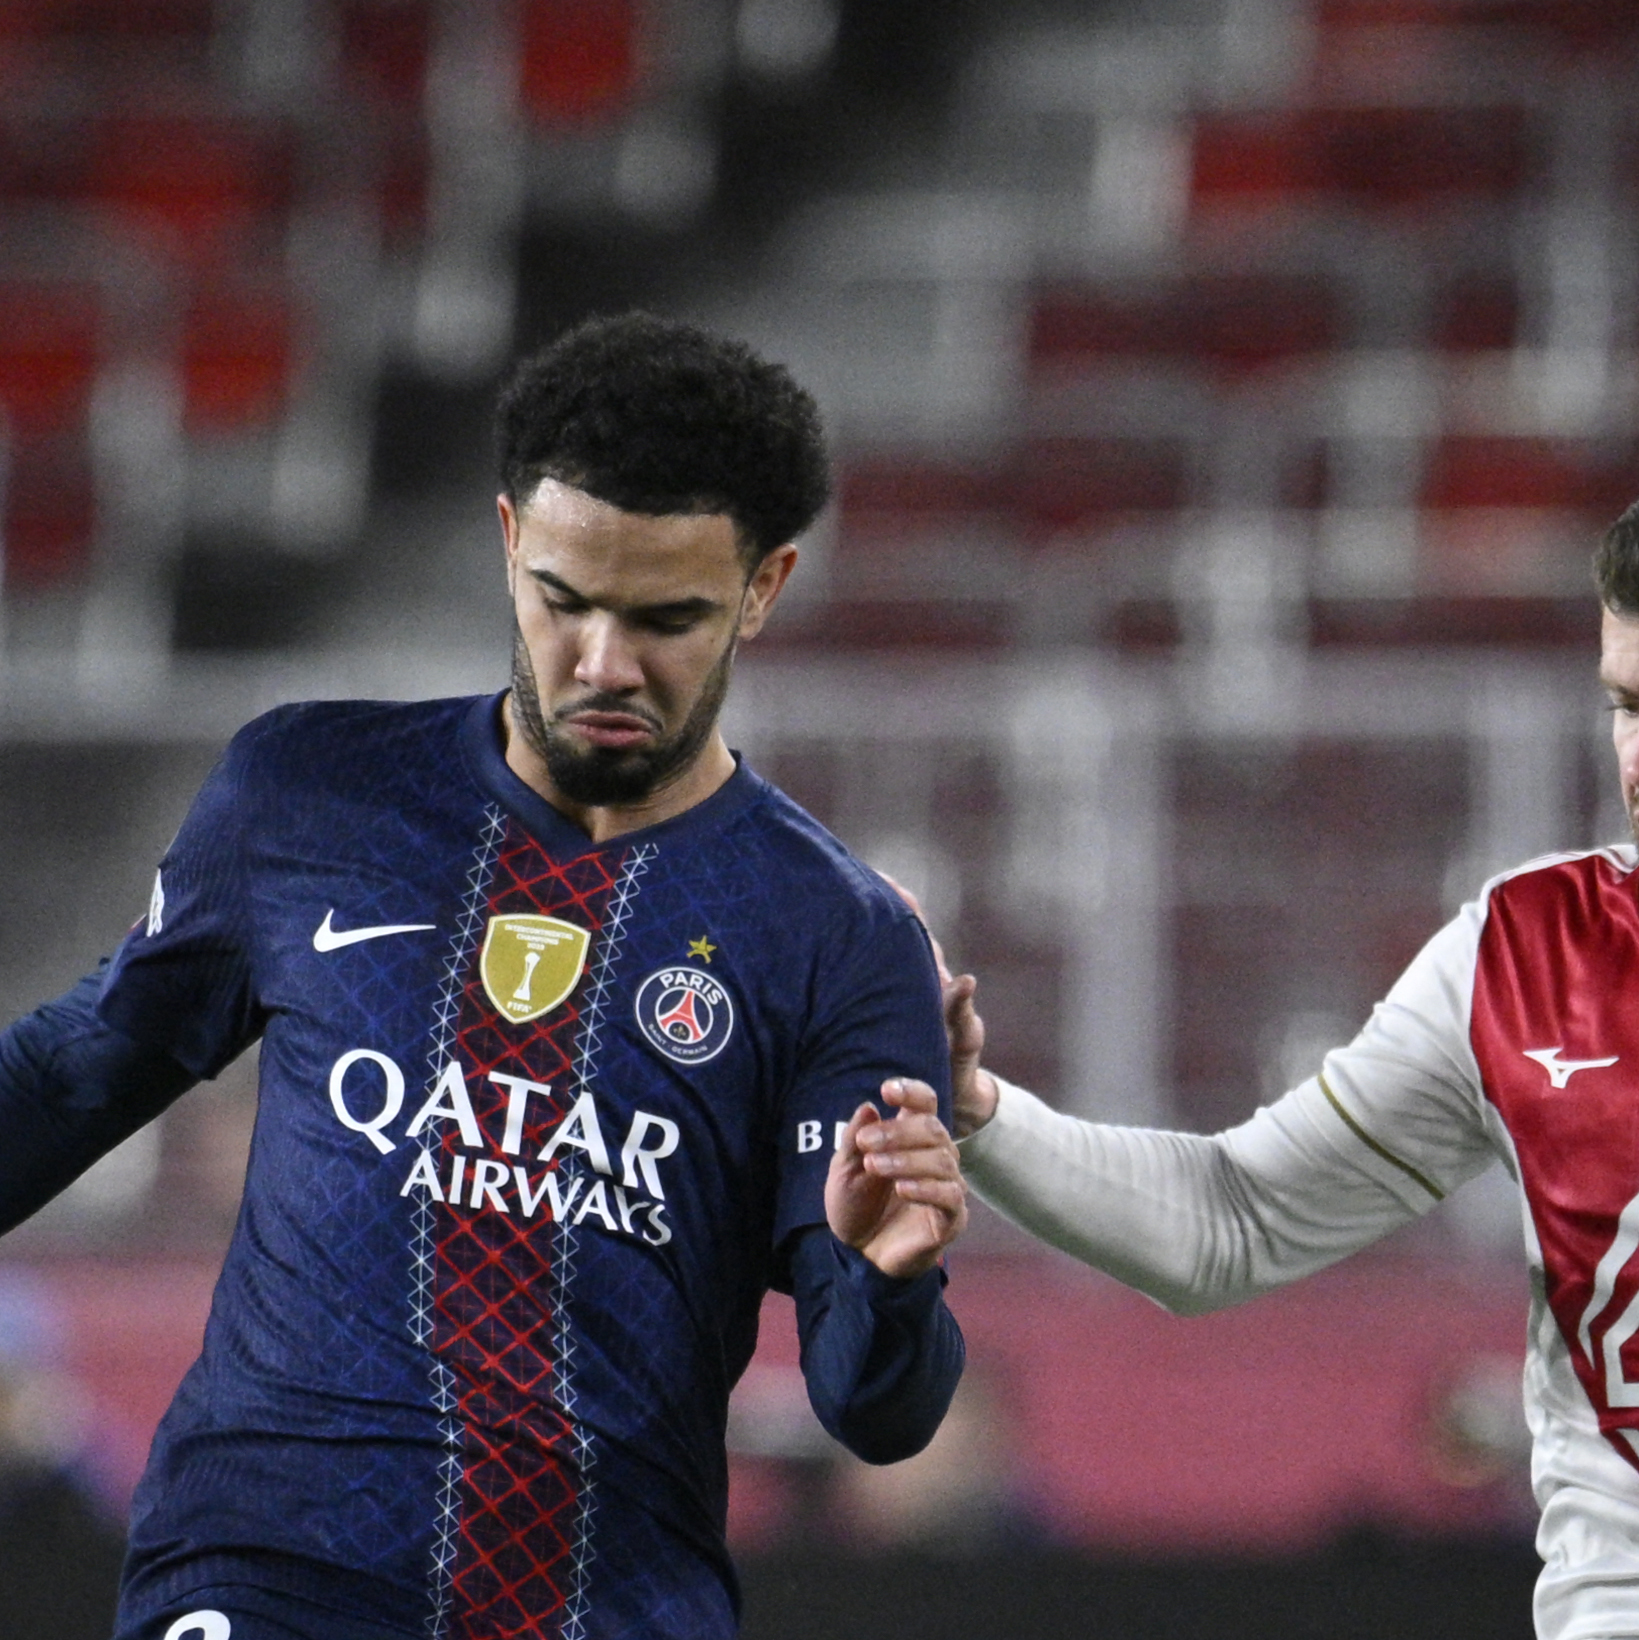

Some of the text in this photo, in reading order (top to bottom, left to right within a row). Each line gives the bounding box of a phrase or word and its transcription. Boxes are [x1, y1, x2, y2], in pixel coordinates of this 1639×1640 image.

[659, 972, 723, 1005] PARIS
[329, 1048, 679, 1201] QATAR
[400, 1154, 673, 1246] AIRWAYS
